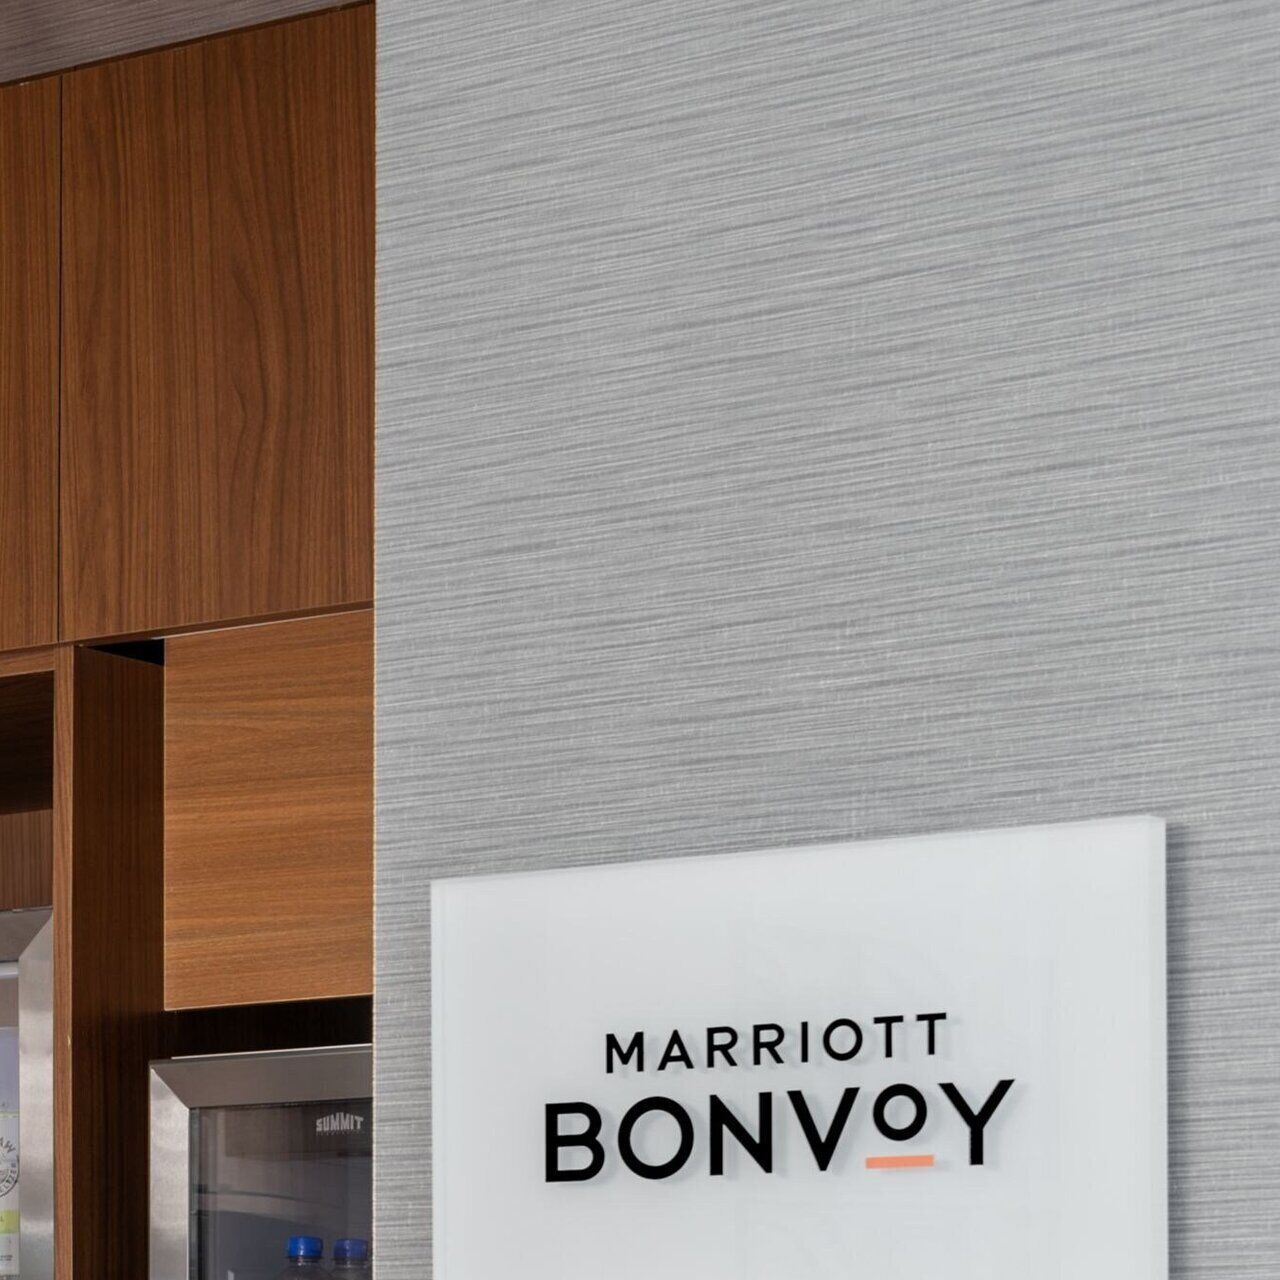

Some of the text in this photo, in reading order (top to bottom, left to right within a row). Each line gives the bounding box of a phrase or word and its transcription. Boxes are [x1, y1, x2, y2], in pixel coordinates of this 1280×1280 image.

[606, 1012, 947, 1073] MARRIOTT
[316, 1112, 364, 1132] SUMMIT
[545, 1079, 1015, 1182] BONVOY
